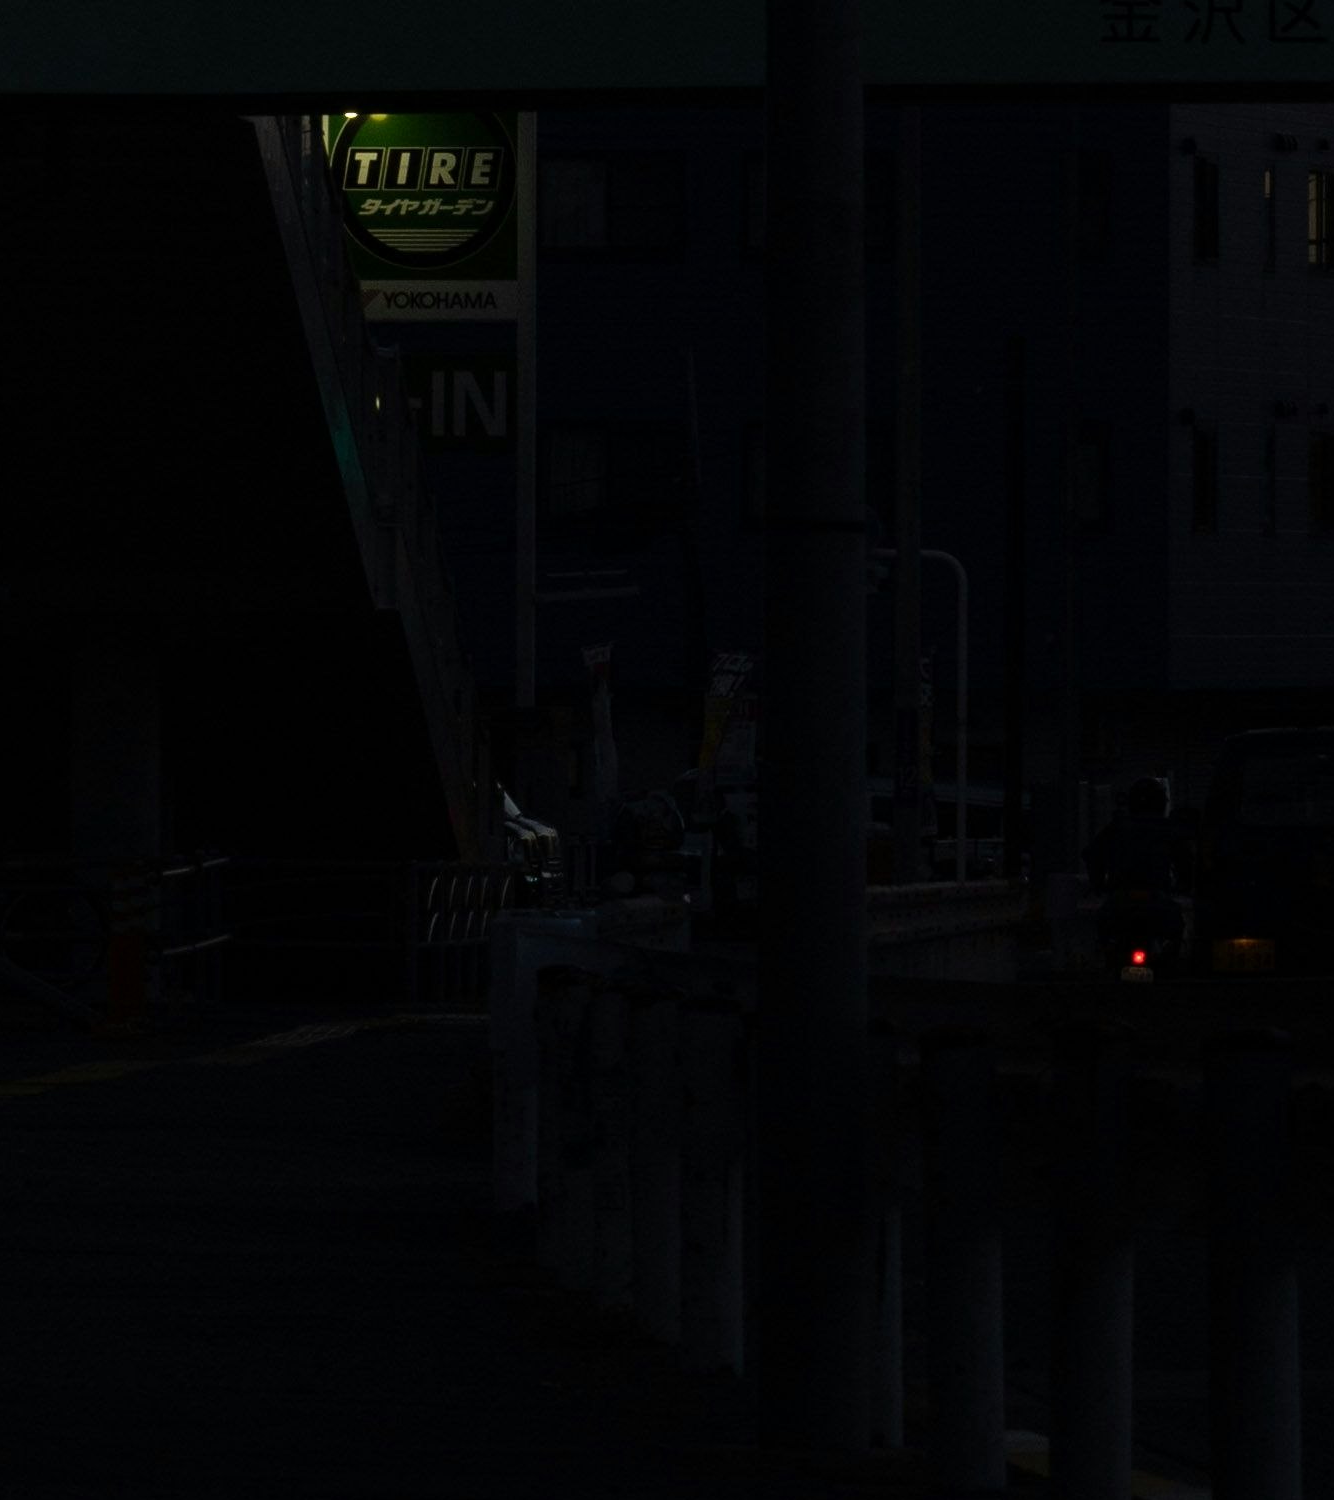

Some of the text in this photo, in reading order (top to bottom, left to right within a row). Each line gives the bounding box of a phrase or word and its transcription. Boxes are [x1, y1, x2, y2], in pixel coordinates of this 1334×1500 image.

[353, 152, 494, 186] TIRE
[357, 197, 497, 217] タイヤガーデン
[382, 290, 498, 311] YOKOHAMA
